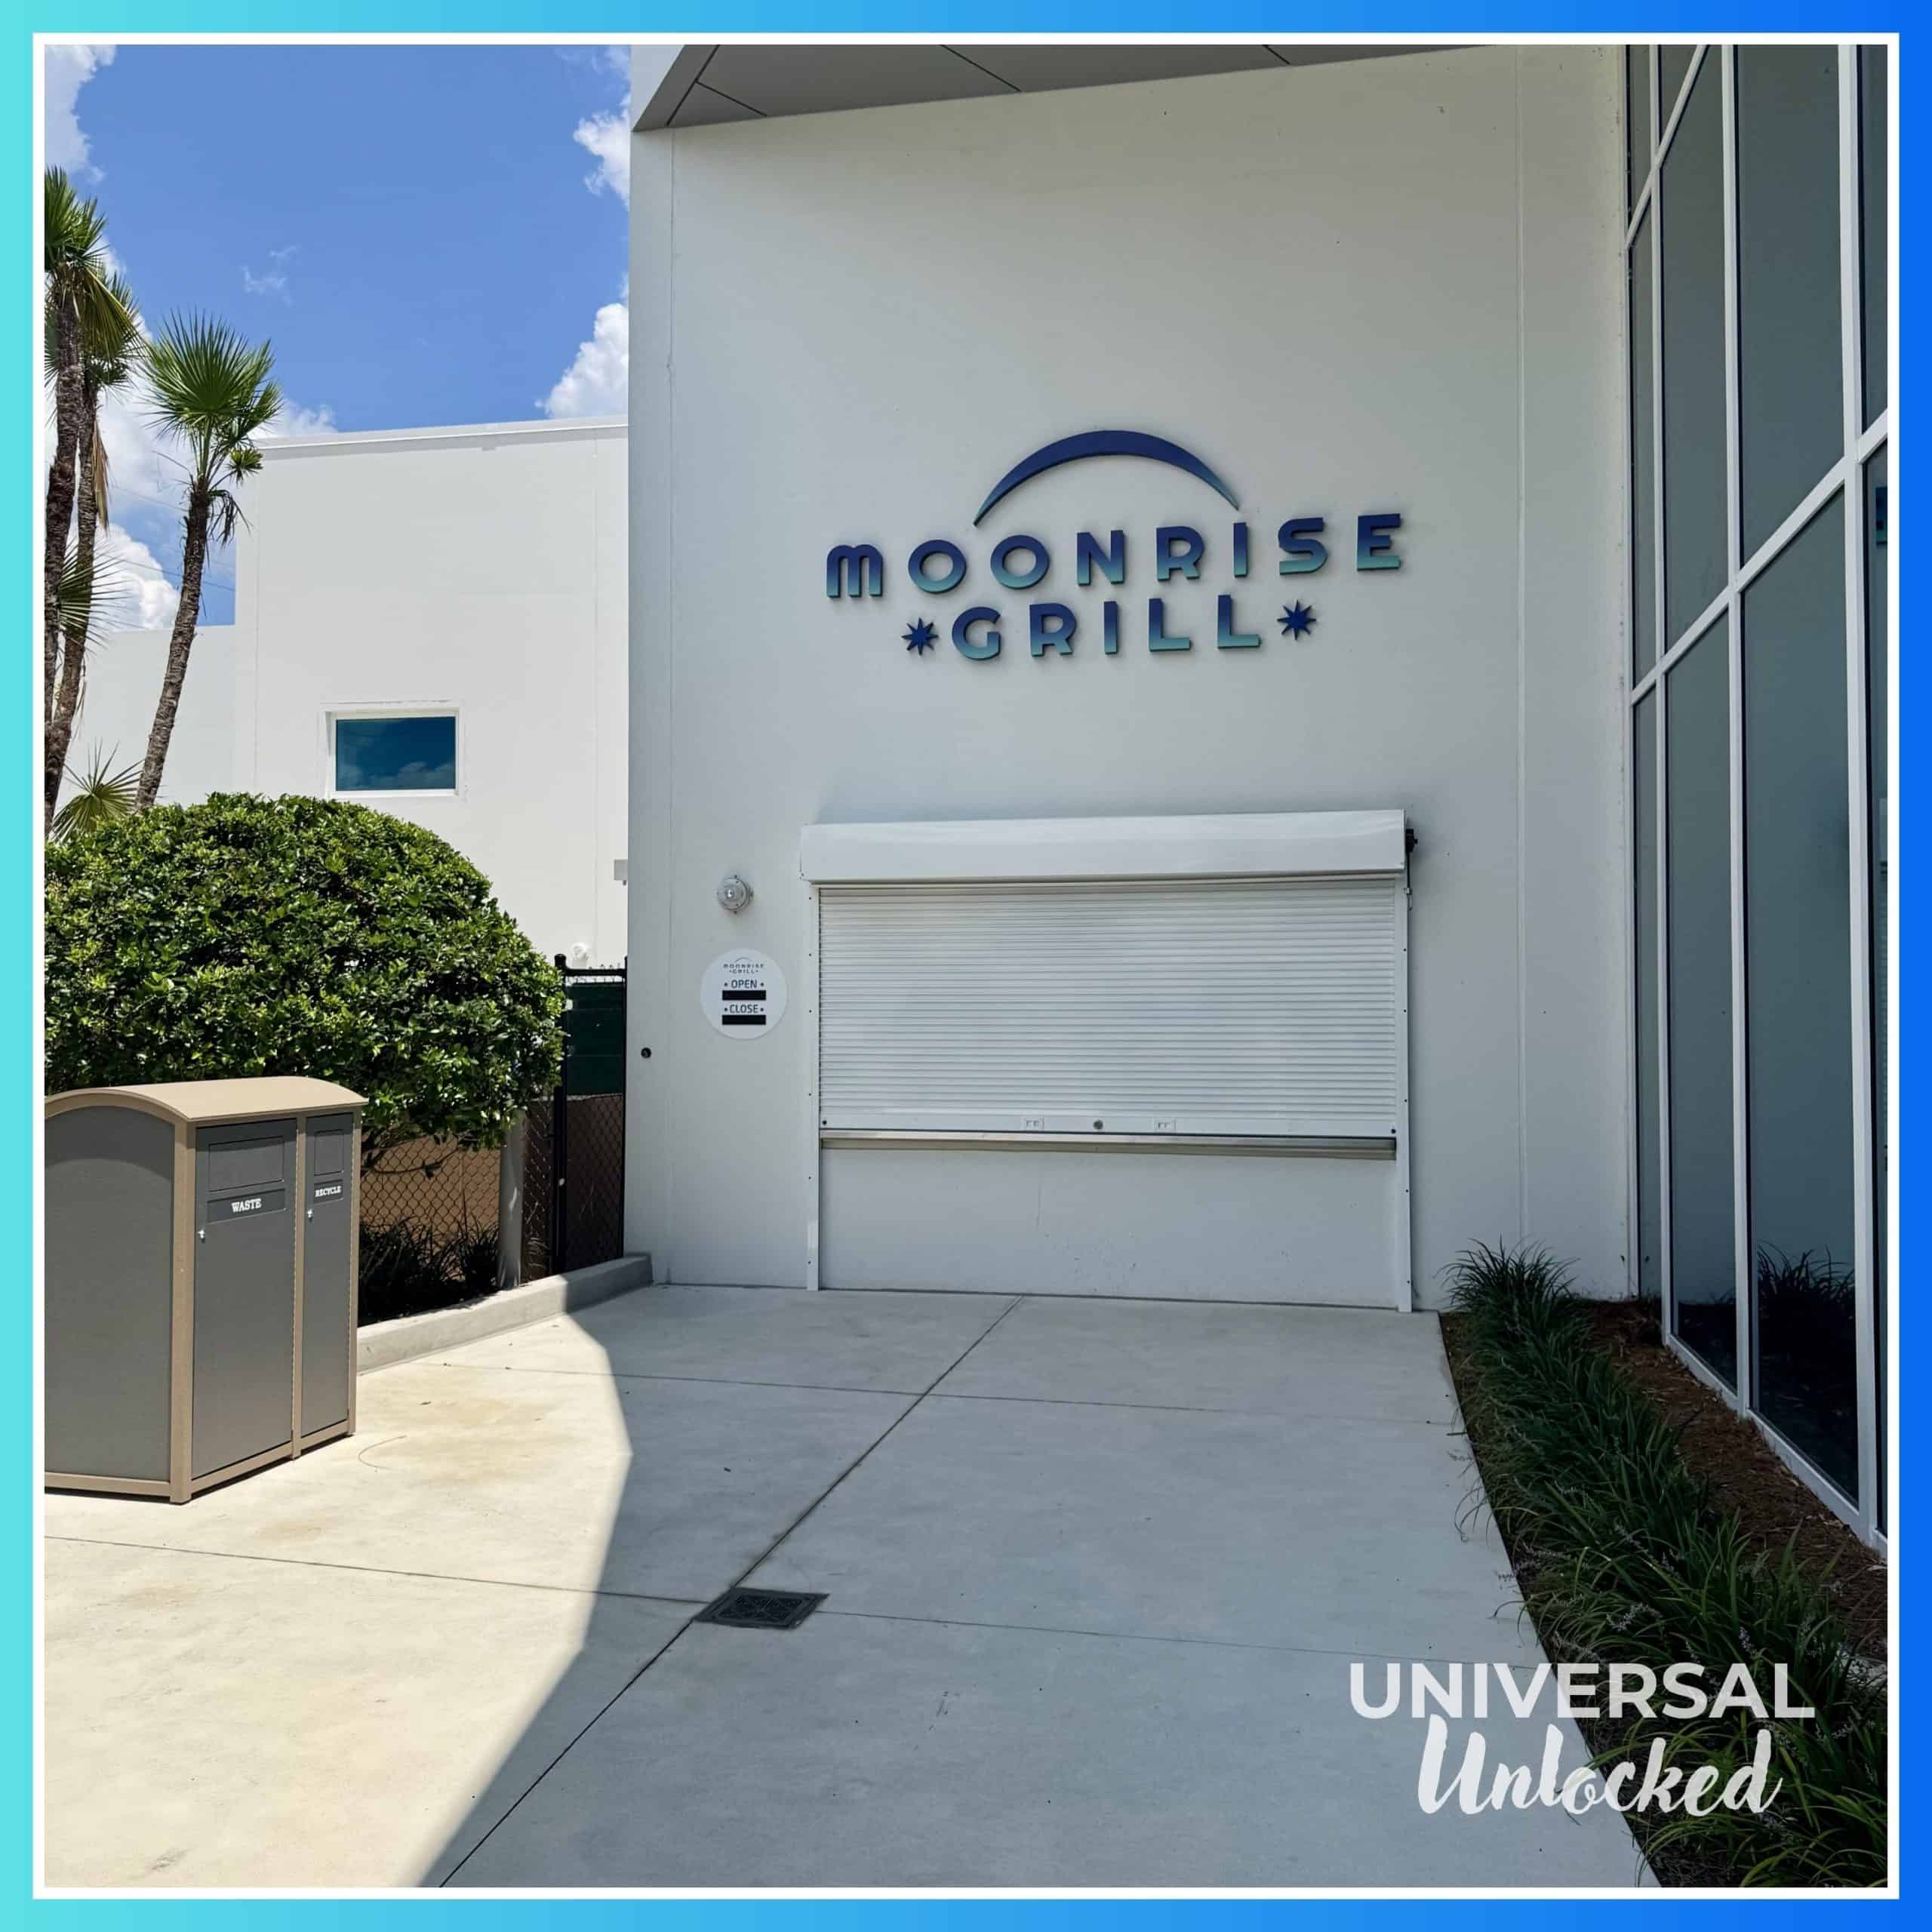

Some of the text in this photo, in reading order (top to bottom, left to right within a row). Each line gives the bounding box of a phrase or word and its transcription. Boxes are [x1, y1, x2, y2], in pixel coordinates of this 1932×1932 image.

[826, 513, 1402, 598] MOONRISE
[951, 594, 1263, 662] GRILL
[731, 980, 758, 989] OPEN
[729, 1004, 758, 1014] CLOSE
[315, 1186, 341, 1197] RECYCLE
[231, 1198, 262, 1213] WASTE
